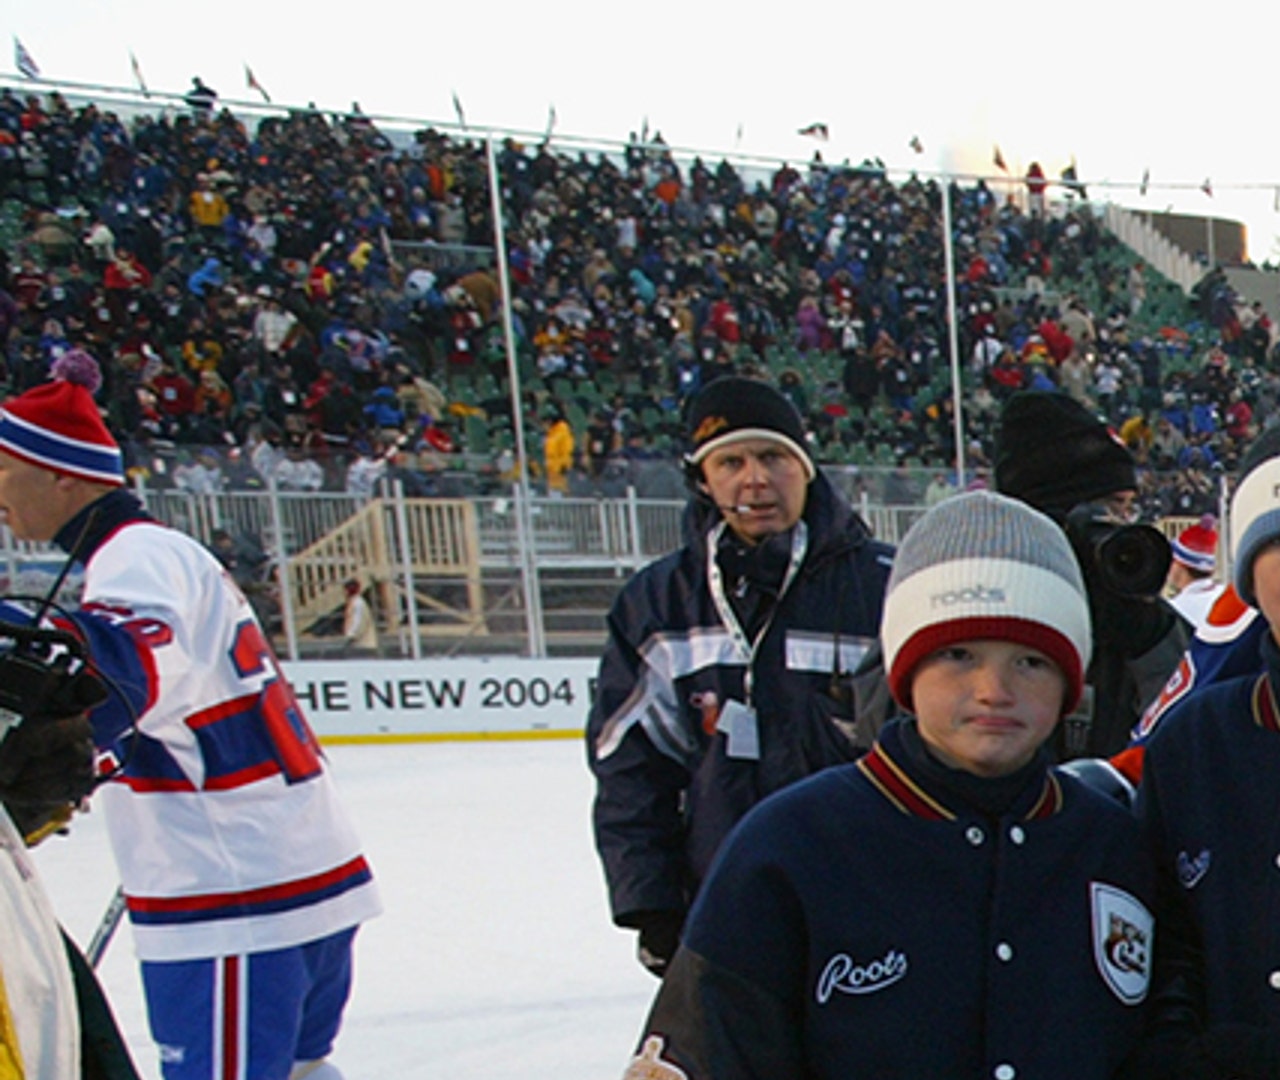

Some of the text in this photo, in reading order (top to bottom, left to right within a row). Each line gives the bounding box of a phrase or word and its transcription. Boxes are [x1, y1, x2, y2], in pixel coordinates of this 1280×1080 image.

[930, 584, 1006, 609] roots
[289, 681, 350, 711] HE
[364, 680, 466, 709] NEW
[480, 678, 575, 708] 2004
[816, 951, 907, 1004] Roots
